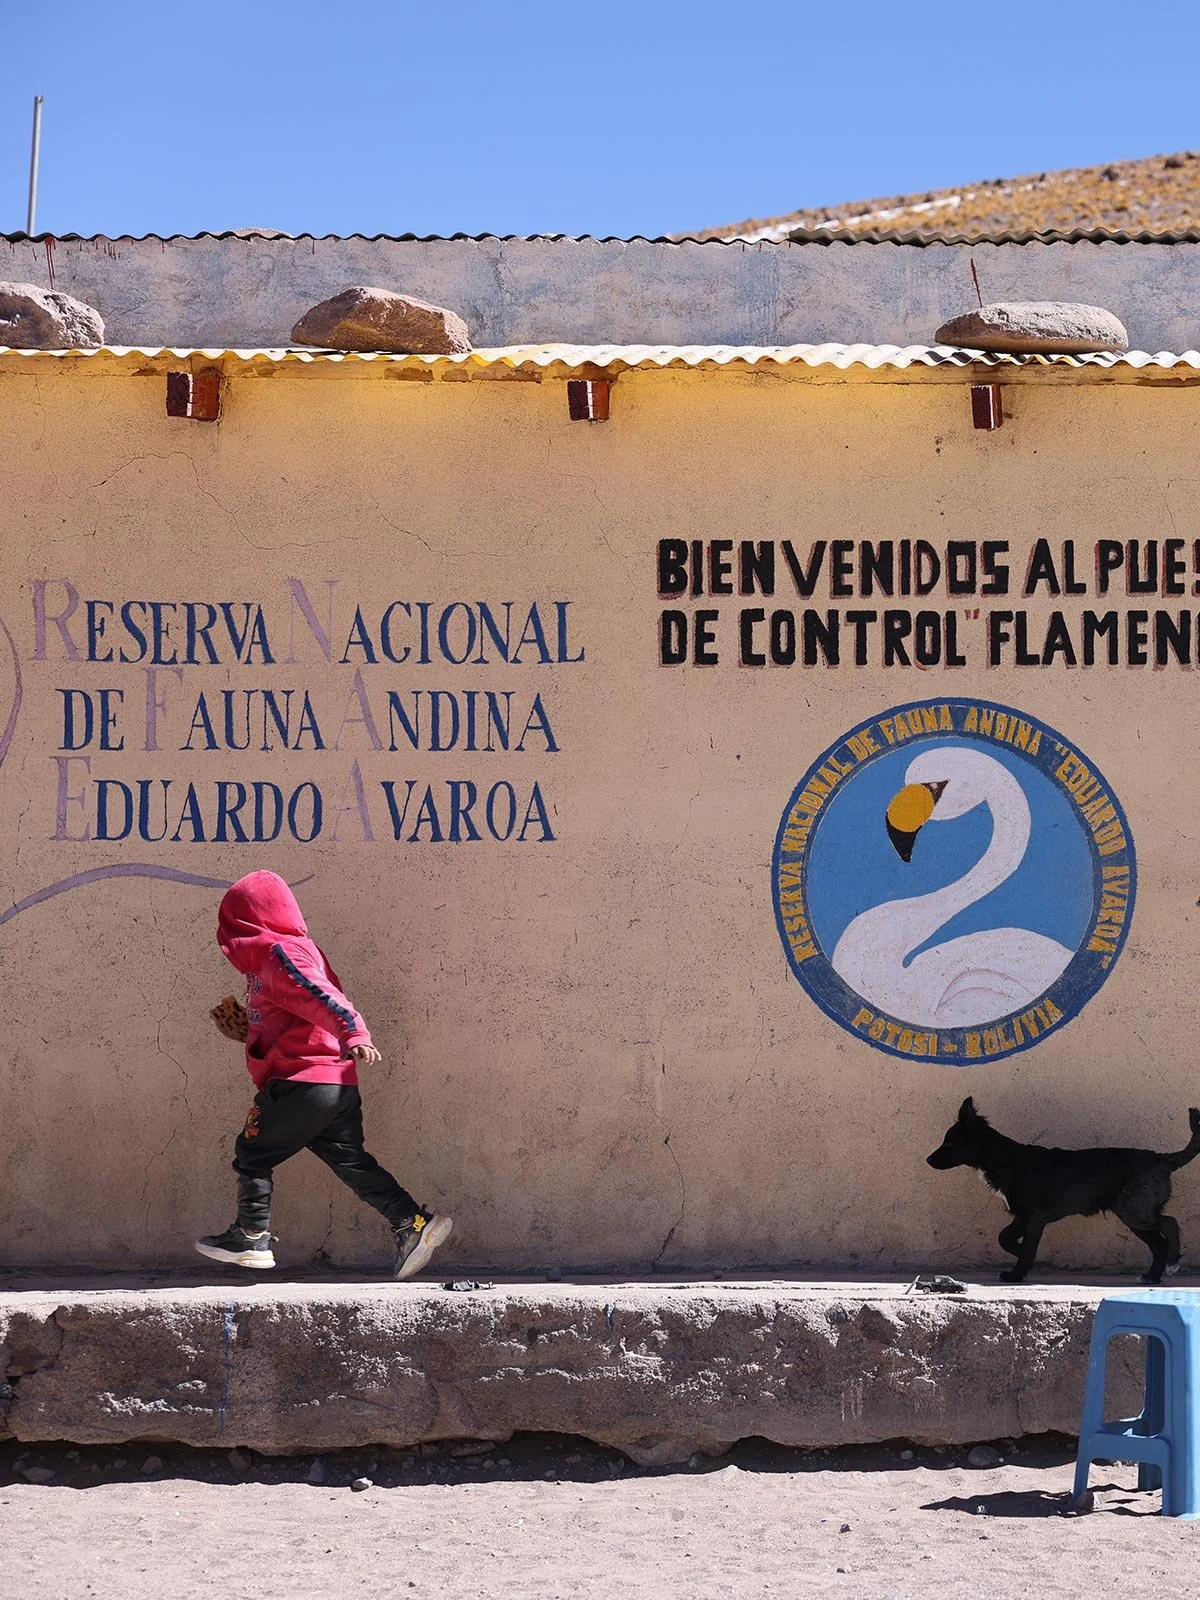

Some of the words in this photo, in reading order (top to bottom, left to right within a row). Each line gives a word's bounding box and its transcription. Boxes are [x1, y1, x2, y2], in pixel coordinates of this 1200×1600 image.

[656, 538, 1009, 599] BIENVENIDOS
[1020, 538, 1087, 597] AL
[29, 579, 276, 665] RESERVA
[285, 577, 586, 665] NACIONAL
[657, 608, 719, 669] DE
[738, 608, 966, 670] CONTROL
[56, 688, 124, 751] DE
[139, 667, 325, 752] FAUNA
[333, 667, 560, 752] ANDINA
[879, 705, 953, 744] FAUNA
[963, 706, 1043, 757] ANDINA
[846, 728, 880, 761] DE
[49, 756, 323, 842] EDUARDO
[329, 757, 556, 842] AVAROA
[780, 756, 852, 852] NACIONAL
[779, 861, 819, 964] RESERVA
[852, 1007, 938, 1056] POTOSI
[966, 997, 1064, 1058] BOLIVIA
